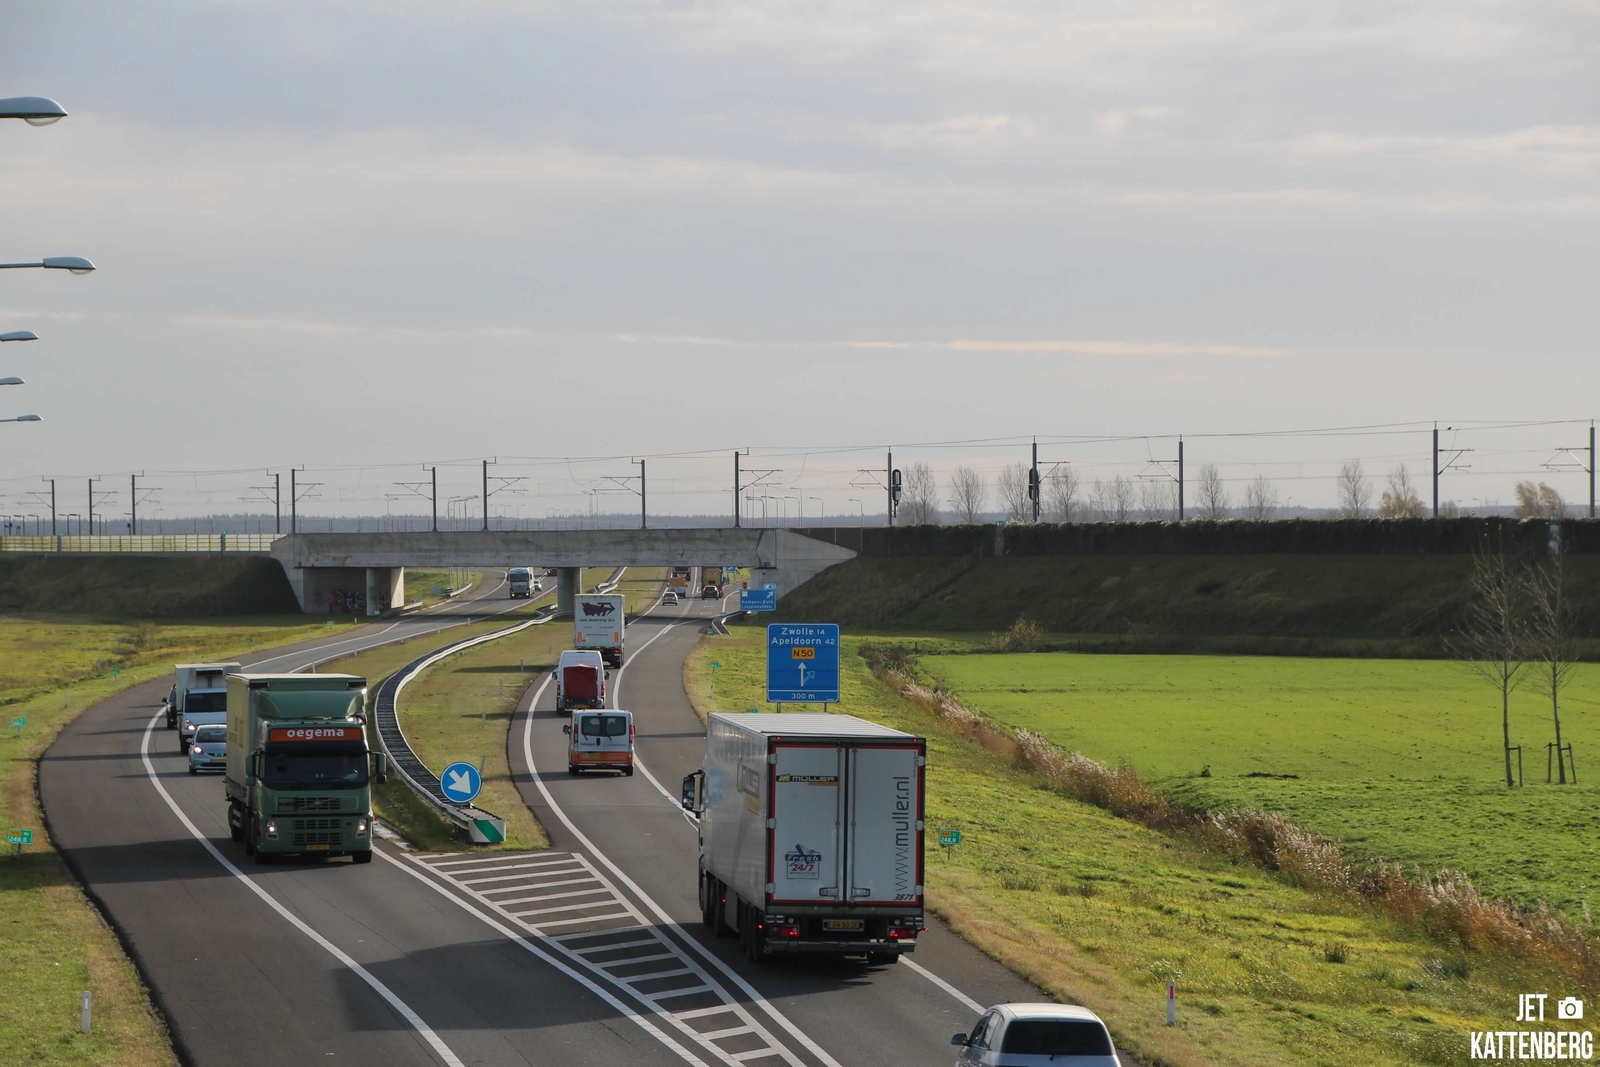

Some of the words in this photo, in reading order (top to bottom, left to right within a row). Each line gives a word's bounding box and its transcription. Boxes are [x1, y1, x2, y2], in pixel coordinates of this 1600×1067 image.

[772, 637, 821, 646] Apeldoorn
[287, 729, 344, 740] oegema
[892, 777, 910, 891] www.muller.nl
